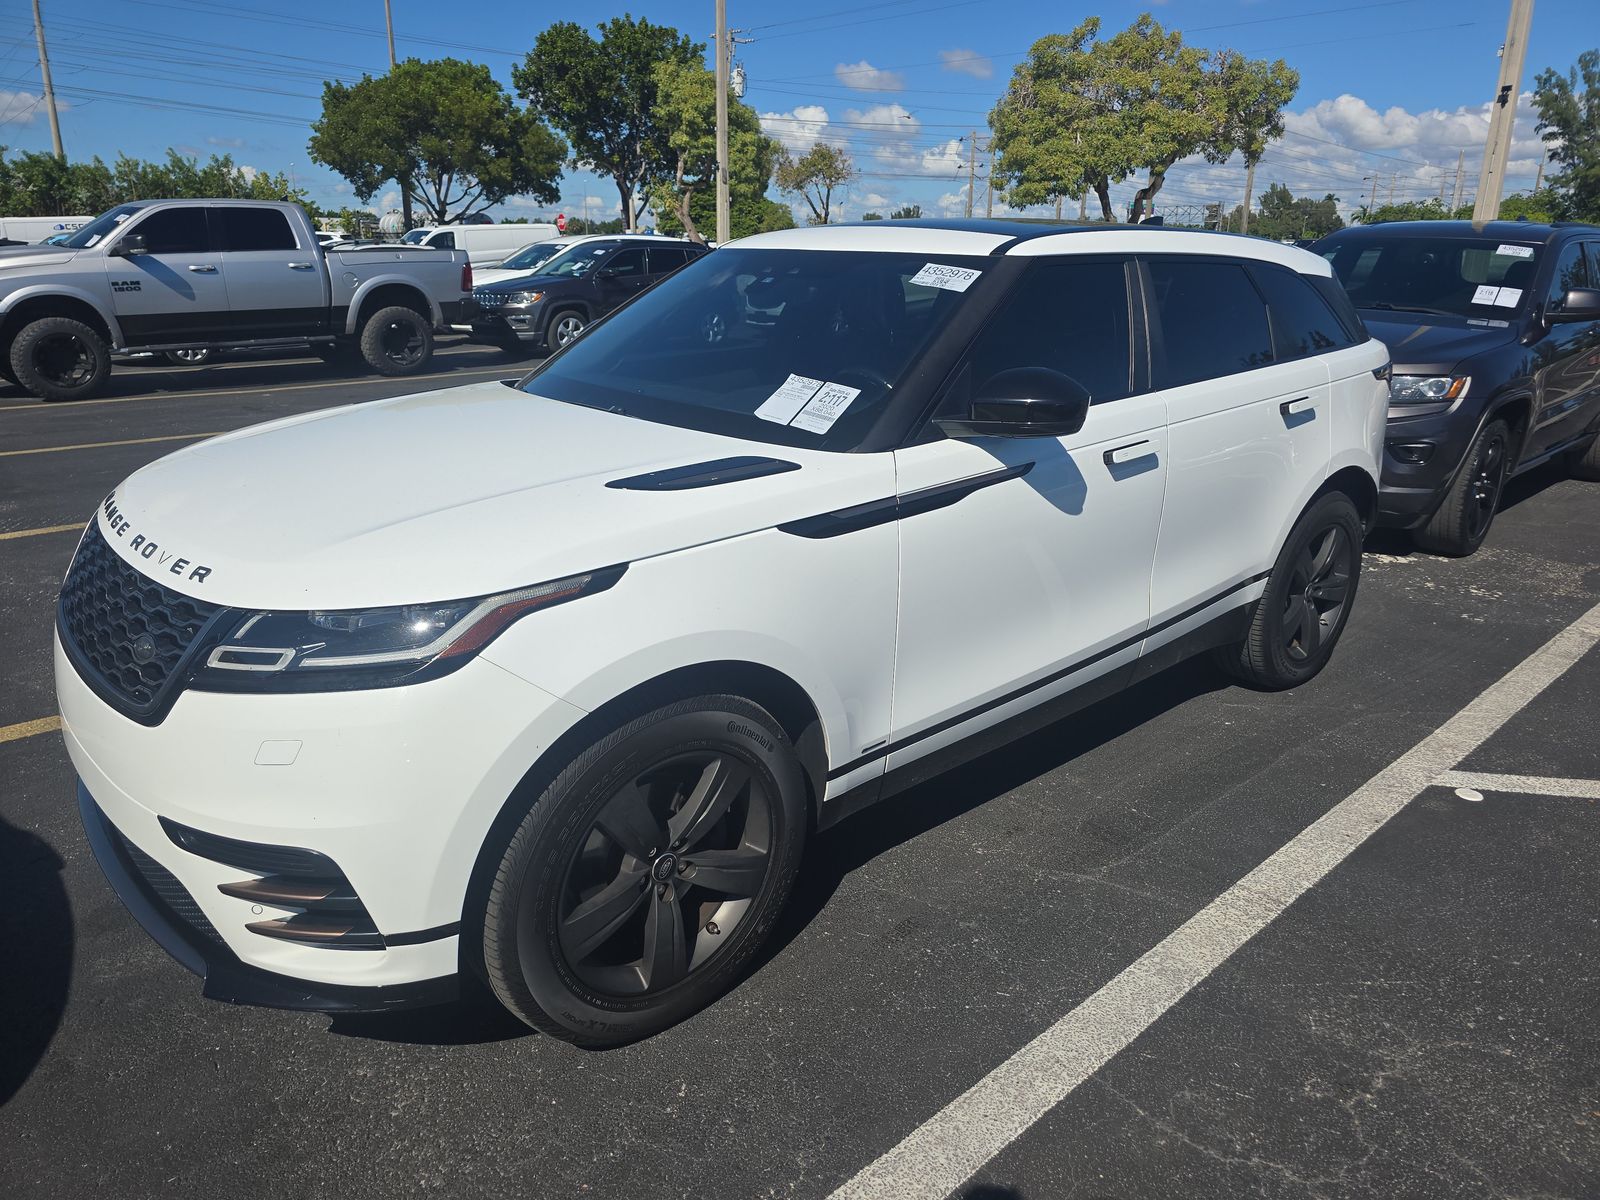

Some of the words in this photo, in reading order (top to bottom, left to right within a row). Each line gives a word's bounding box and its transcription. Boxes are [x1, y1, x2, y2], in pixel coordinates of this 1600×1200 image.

[922, 265, 975, 281] 4352978
[790, 375, 823, 388] 4352978
[818, 391, 848, 408] 2:117
[104, 490, 131, 537] RANGE
[129, 533, 213, 584] ROVER
